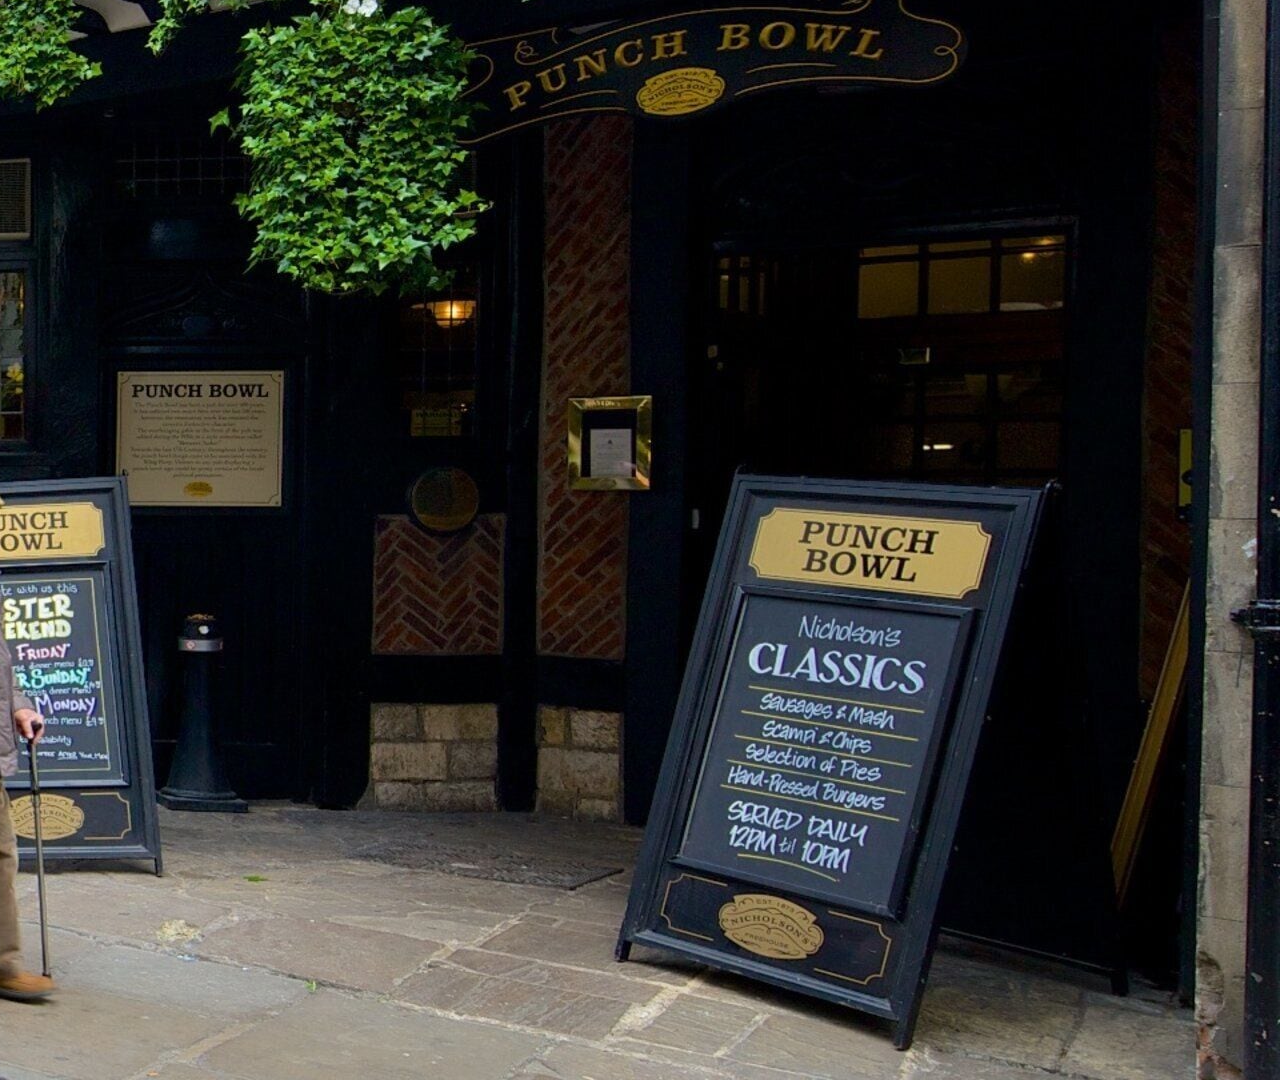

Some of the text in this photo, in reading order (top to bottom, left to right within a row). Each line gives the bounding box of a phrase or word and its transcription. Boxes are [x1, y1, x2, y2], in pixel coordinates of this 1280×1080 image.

[503, 21, 887, 113] PUNCH BOWL
[131, 384, 269, 398] PUNCH BOWL
[798, 520, 939, 556] PUNCH
[802, 548, 918, 583] BOWL
[17, 583, 38, 594] with
[40, 584, 53, 594] us
[57, 583, 78, 594] this
[3, 594, 74, 622] STER
[4, 618, 72, 640] EKEND
[798, 615, 901, 649] Nicholson's
[16, 643, 71, 662] FRIDAY
[747, 641, 927, 696] CLASSICS
[34, 693, 96, 716] MONDAY
[61, 717, 82, 725] menu
[760, 692, 834, 721] Sausages
[849, 706, 895, 730] Mash
[761, 720, 819, 747] Scampi
[832, 731, 873, 755] Chips
[745, 743, 882, 783] Selection of Pies
[727, 765, 886, 812] Hand-Pressed Burgers
[727, 799, 869, 846] SERVED DAILY
[728, 824, 778, 855] 12PM
[801, 841, 849, 874] 10PM
[730, 914, 809, 945] NICHOLSON'S
[744, 932, 790, 949] FREEHOUSE
